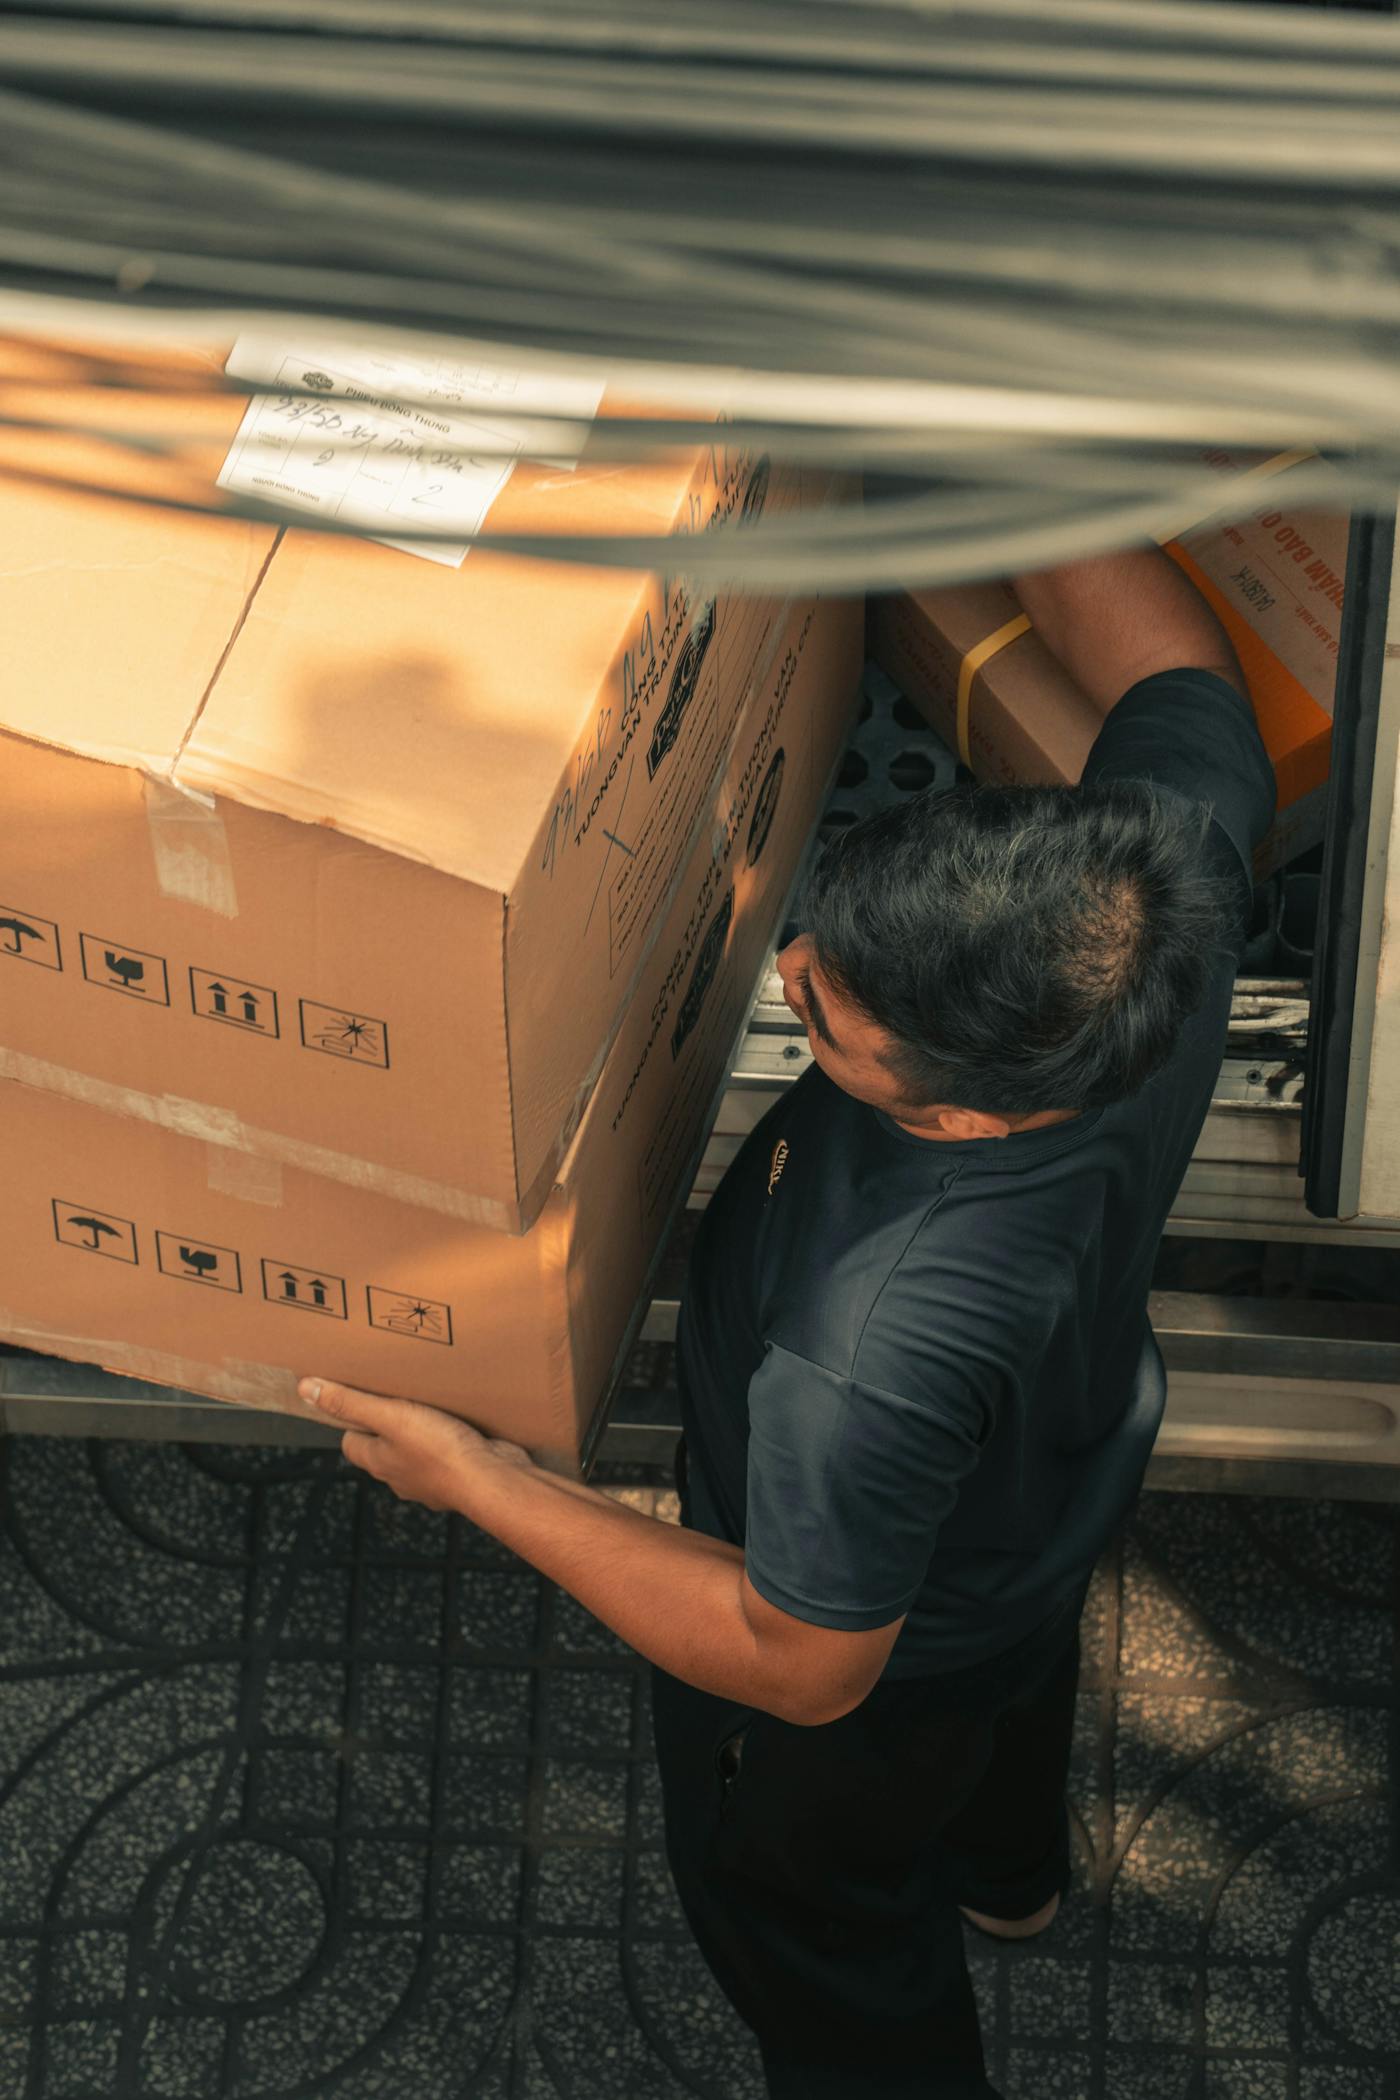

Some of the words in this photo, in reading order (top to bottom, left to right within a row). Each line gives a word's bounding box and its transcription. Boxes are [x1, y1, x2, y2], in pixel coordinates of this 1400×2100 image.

[574, 708, 641, 848] TUONGVAN
[611, 999, 669, 1132] TUONGVAN
[670, 889, 714, 994] TRADING
